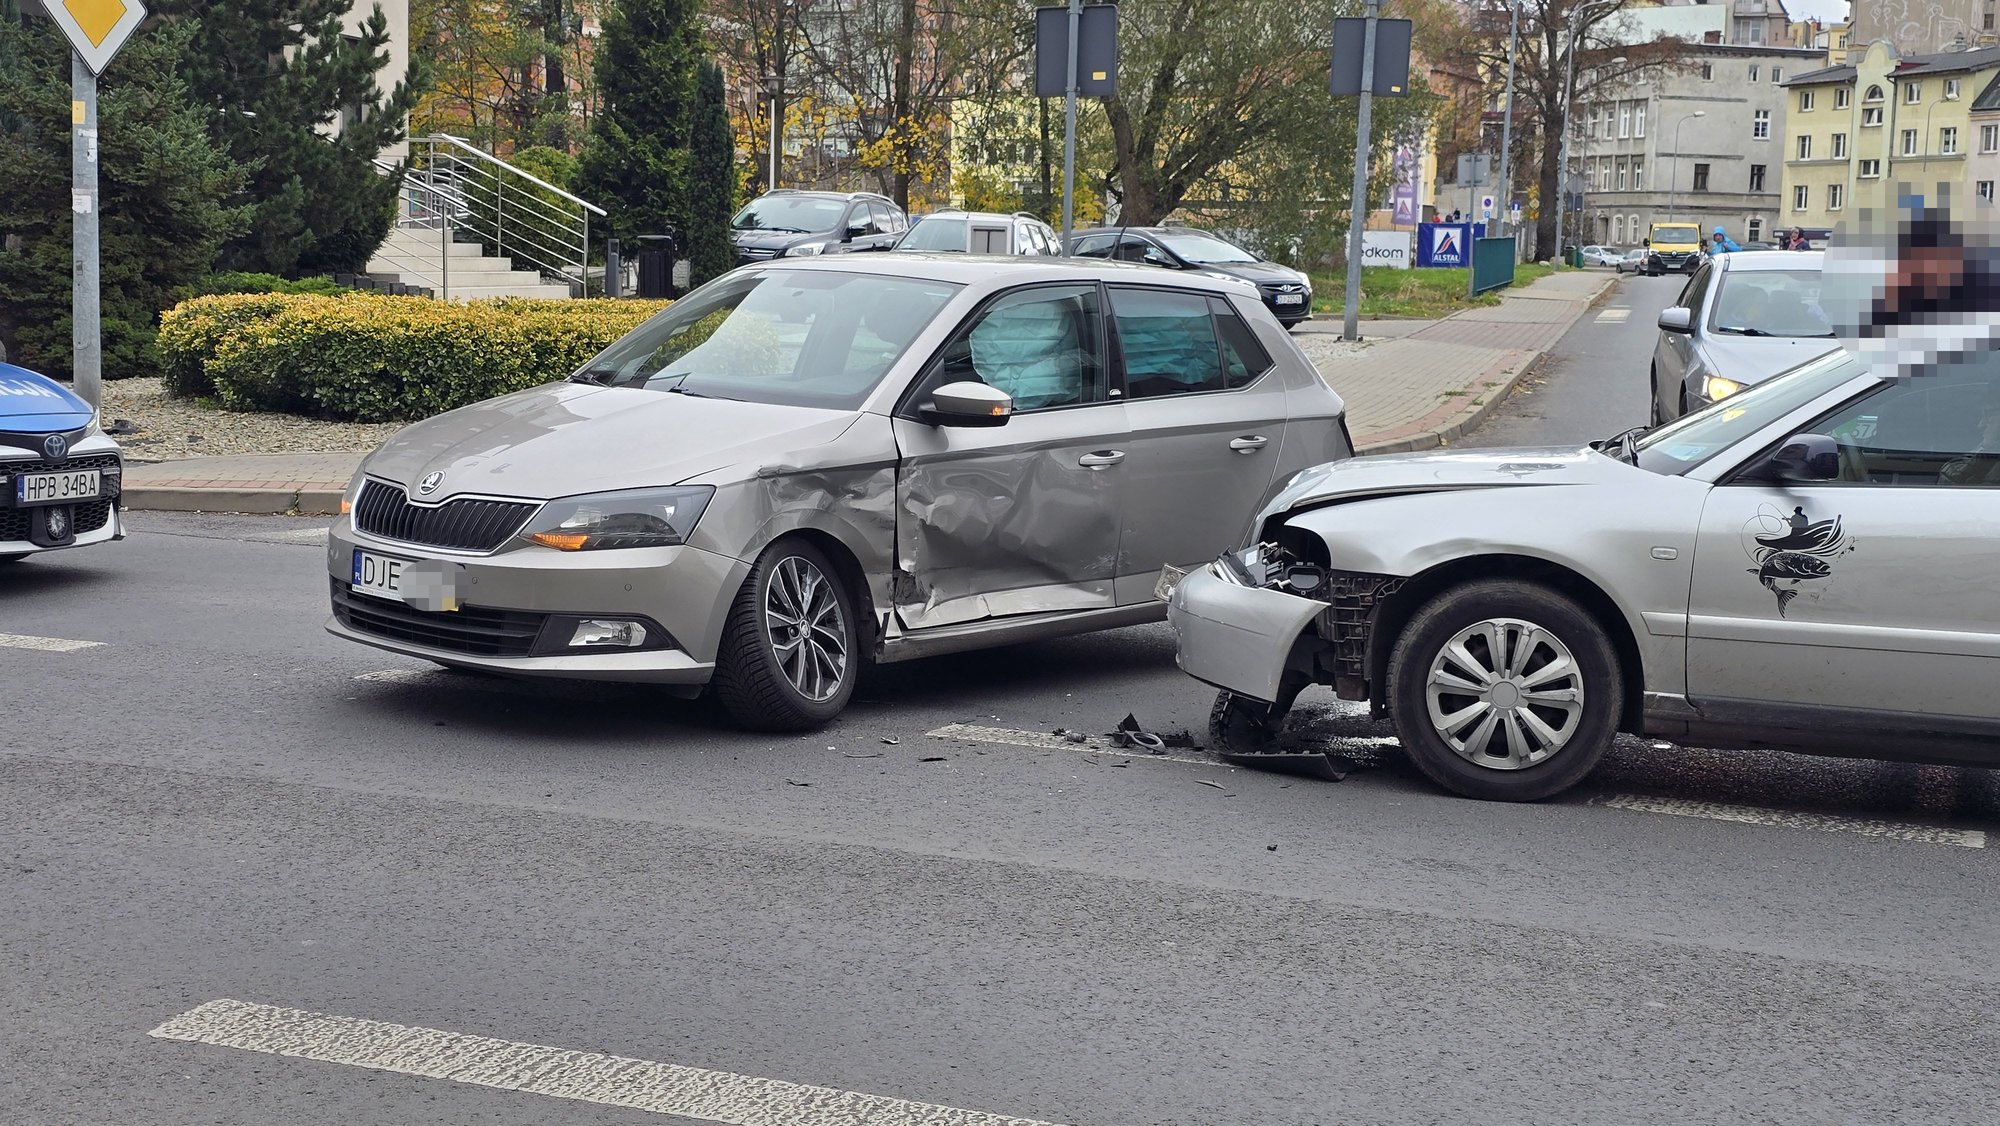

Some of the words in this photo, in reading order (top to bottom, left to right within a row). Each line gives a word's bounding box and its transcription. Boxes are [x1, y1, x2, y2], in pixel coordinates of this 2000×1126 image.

[0, 379, 63, 399] CJA
[27, 477, 57, 500] HPB
[61, 473, 96, 496] 34BA
[355, 572, 361, 580] PL
[364, 556, 401, 590] DJE
